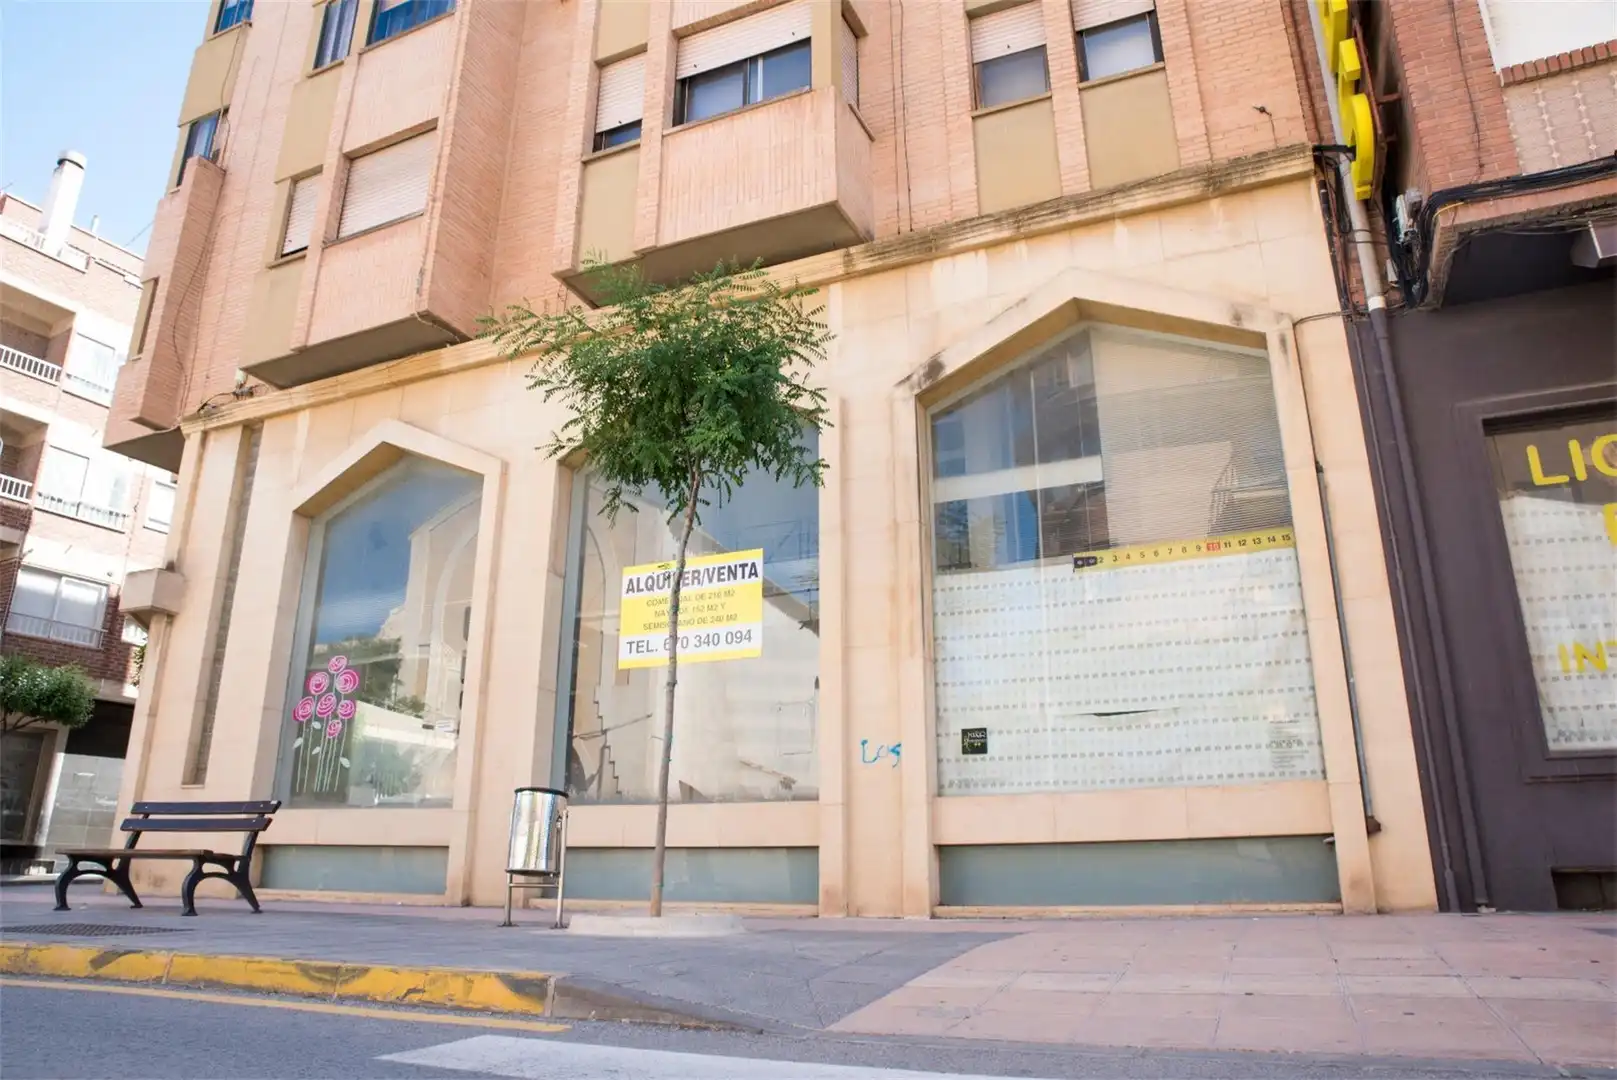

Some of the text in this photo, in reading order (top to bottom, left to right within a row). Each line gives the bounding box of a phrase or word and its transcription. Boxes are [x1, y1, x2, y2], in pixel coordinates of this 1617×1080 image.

[1252, 537, 1261, 545] 13
[1267, 535, 1276, 543] 14
[1281, 533, 1291, 541] 15
[625, 561, 759, 594] ALQUIER/VENTA
[695, 593, 707, 601] DE
[723, 589, 735, 597] M2
[706, 603, 718, 612] M2
[697, 616, 708, 625] DE
[725, 613, 738, 622] M2
[626, 639, 658, 654] TEL.
[693, 632, 720, 648] 340
[725, 629, 752, 645] 094
[1557, 640, 1617, 673] IN
